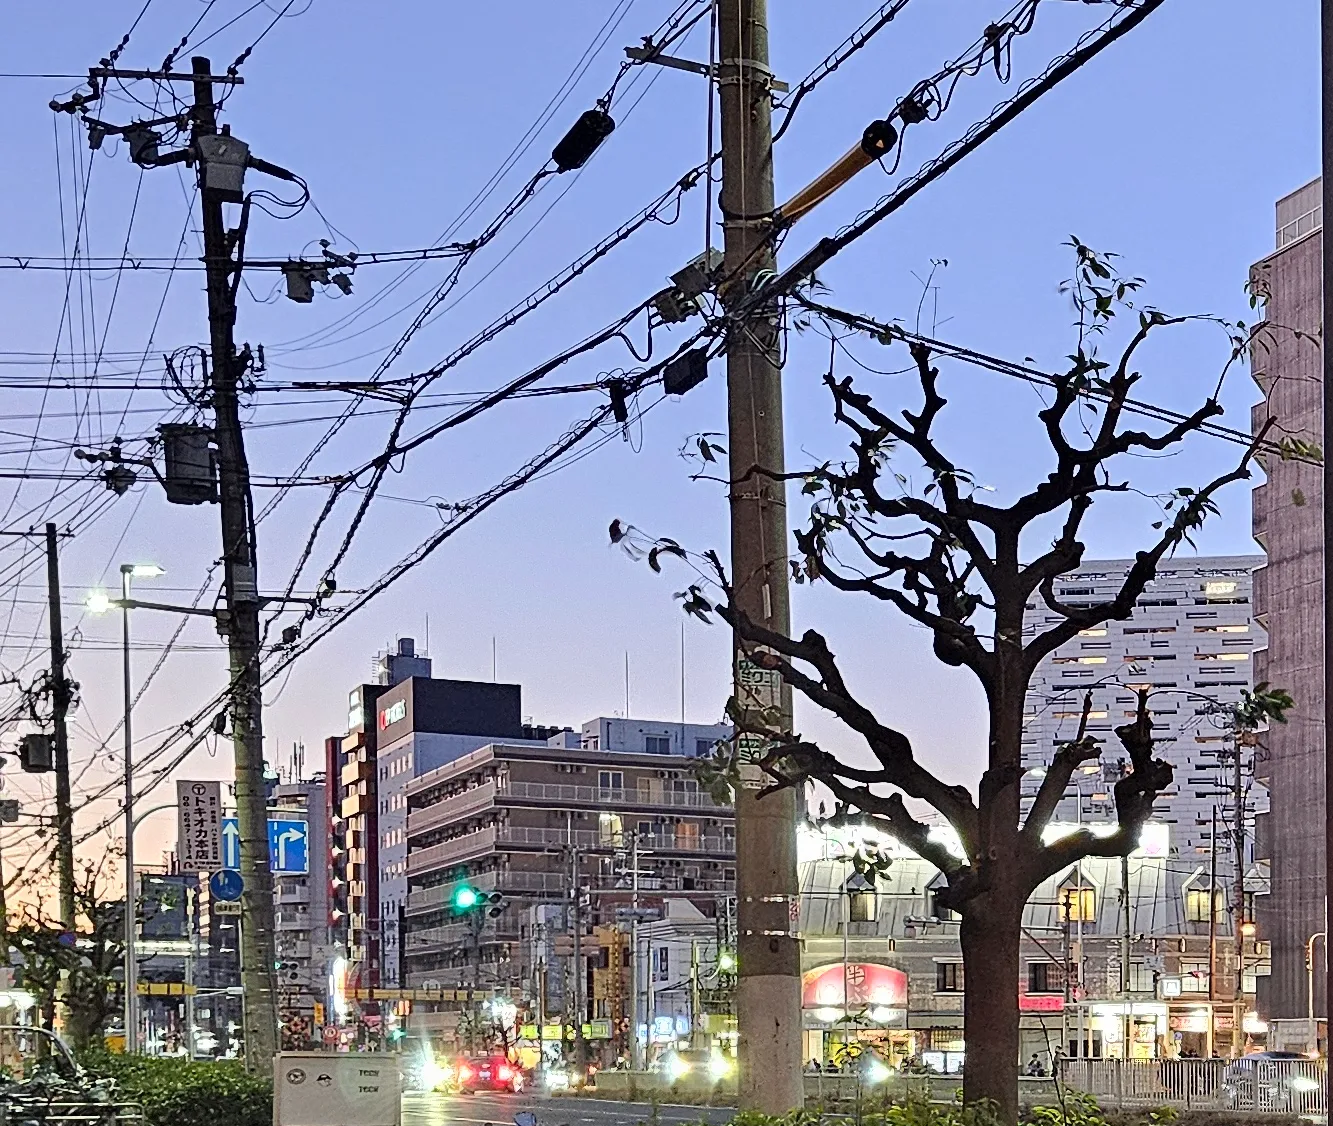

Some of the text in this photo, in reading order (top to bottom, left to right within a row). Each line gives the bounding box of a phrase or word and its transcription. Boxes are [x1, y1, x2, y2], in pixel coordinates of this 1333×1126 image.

[193, 796, 209, 860] トキオカ本店
